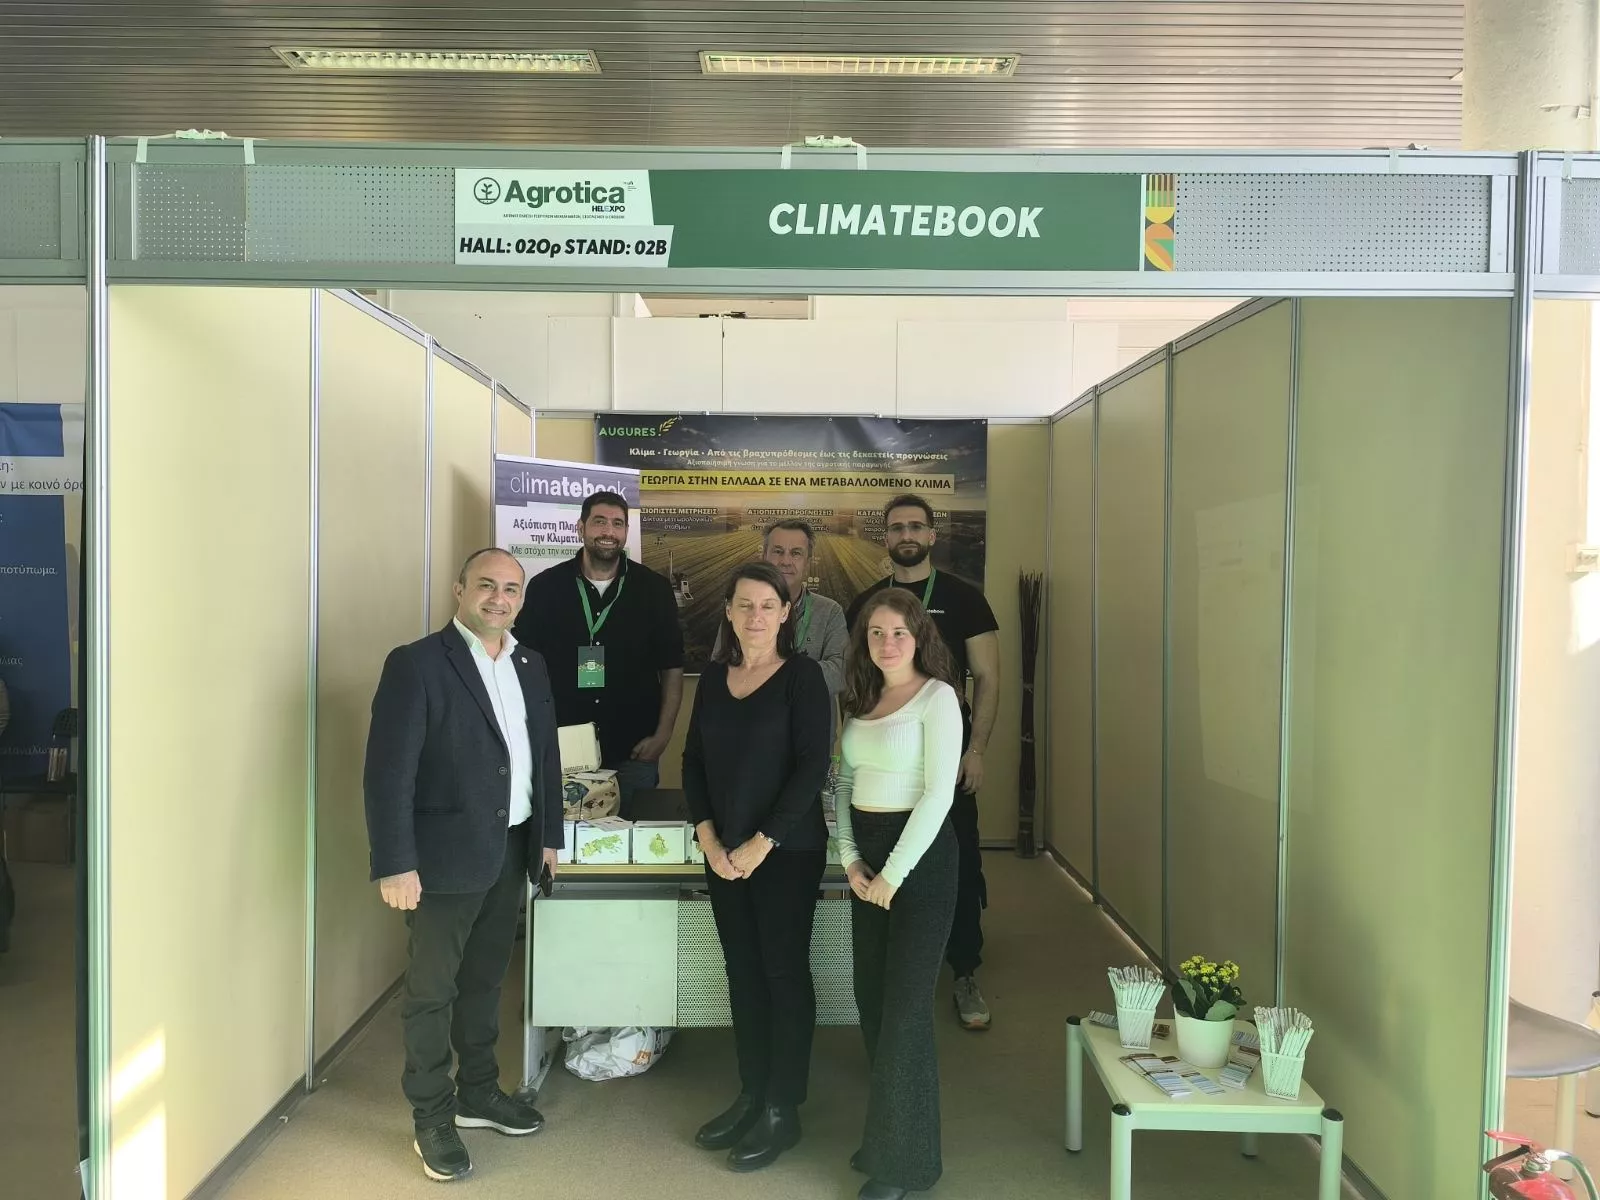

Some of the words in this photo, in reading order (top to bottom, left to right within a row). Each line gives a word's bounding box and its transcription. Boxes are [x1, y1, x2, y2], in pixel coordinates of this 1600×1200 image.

[504, 180, 625, 208] Agrotica
[592, 205, 625, 213] HELEXPO
[768, 202, 1044, 238] CLIMATEBOOK
[460, 237, 511, 254] HALL:
[565, 239, 631, 255] STAND:
[634, 240, 667, 256] 02B
[599, 427, 656, 437] AUGURES
[630, 448, 656, 457] Κλίμα
[664, 448, 699, 458] Γεωργία
[708, 449, 726, 457] Από
[897, 451, 948, 461] προγνώσεις
[11, 481, 25, 492] με
[29, 478, 60, 490] κοινό
[642, 475, 685, 485] ΓΕΩΡΓΙΑ
[688, 476, 717, 485] ΣΤΗΝ
[721, 476, 766, 486] ΕΛΛΑΔΑ
[769, 477, 780, 486] ΣΕ
[784, 477, 806, 486] ΕΝΑ
[810, 477, 911, 487] ΜΕΤΑΒΑΛΛΟΜΕΝΟ
[915, 479, 951, 488] ΚΛΙΜΑ
[513, 518, 556, 531] Αξιόπιστη
[559, 521, 579, 533] Πληρ
[530, 534, 545, 544] την
[547, 533, 584, 544] Κλιματικ
[511, 546, 522, 555] Με
[524, 546, 545, 556] στόχο
[548, 547, 558, 557] την
[560, 547, 577, 556] κατα
